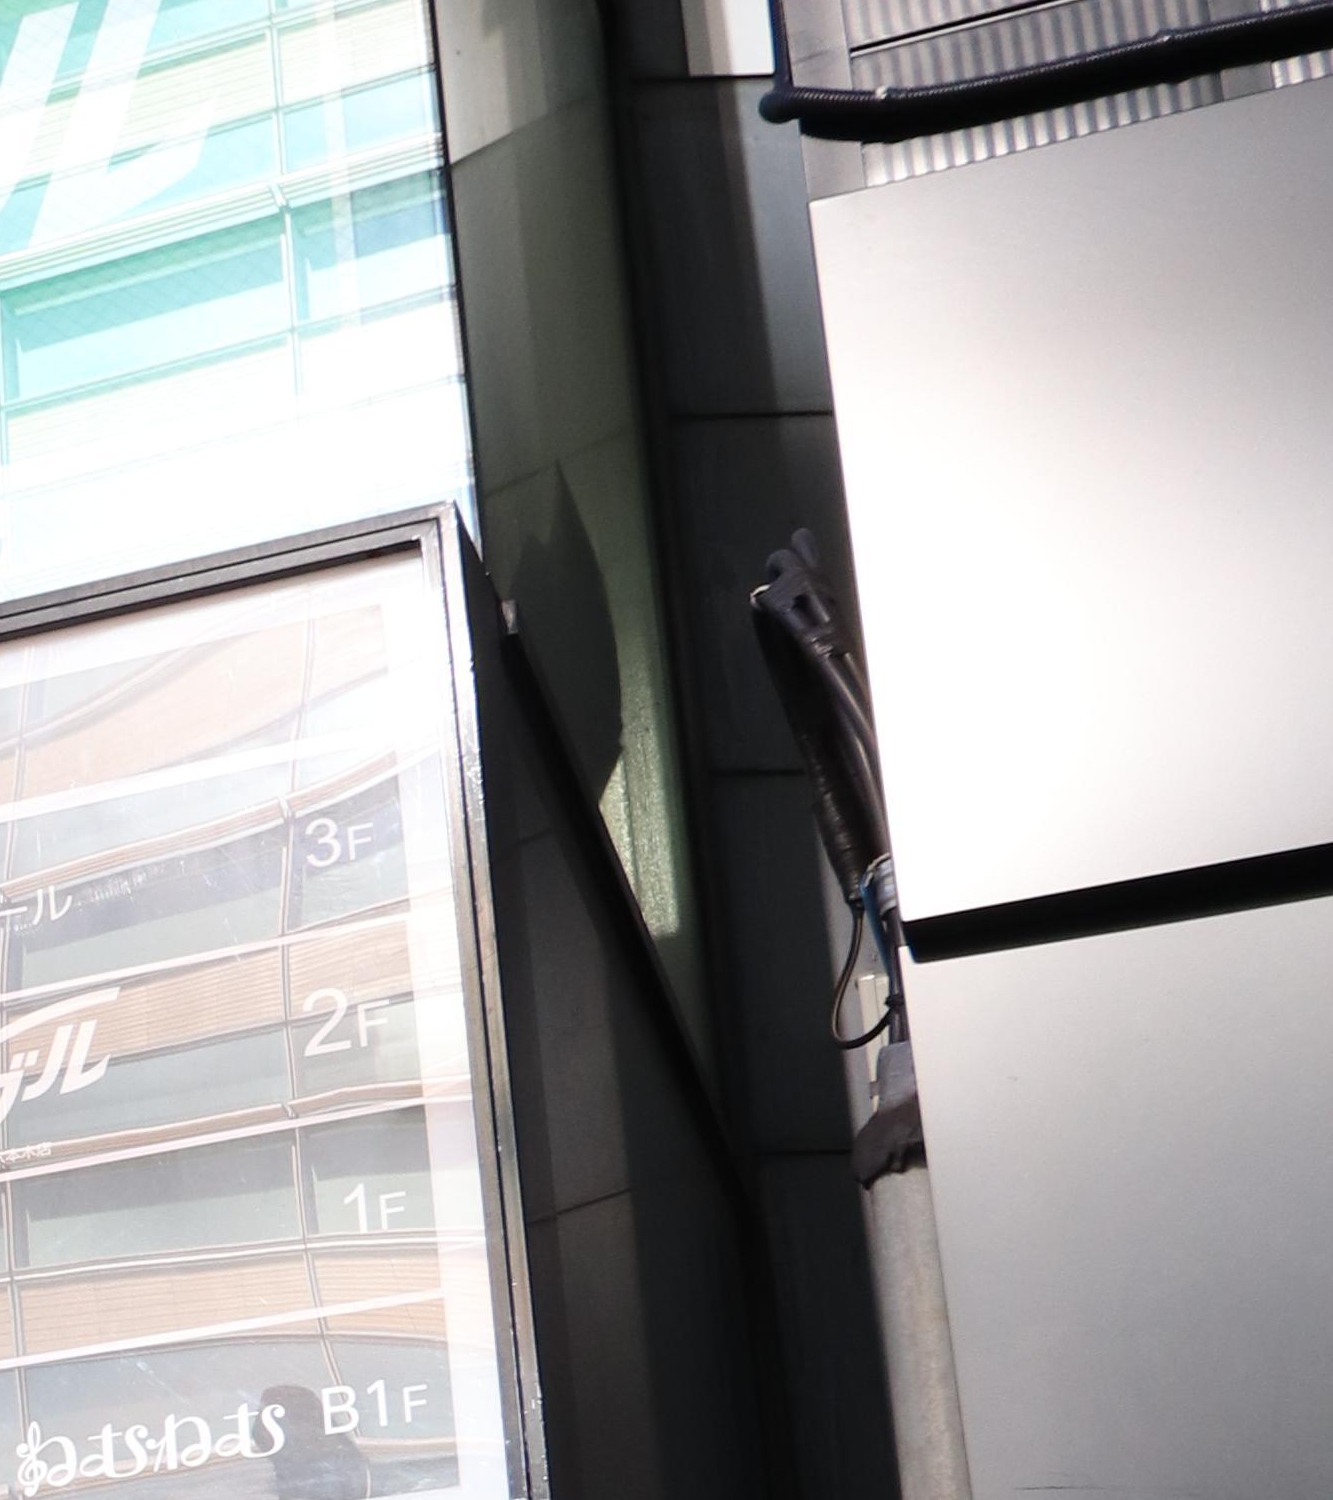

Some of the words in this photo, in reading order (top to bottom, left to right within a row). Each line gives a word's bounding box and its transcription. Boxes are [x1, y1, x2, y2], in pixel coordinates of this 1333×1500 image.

[303, 815, 376, 872] 3F
[301, 987, 393, 1058] 2F
[343, 1181, 409, 1236] 1F
[320, 1376, 430, 1441] B1F
